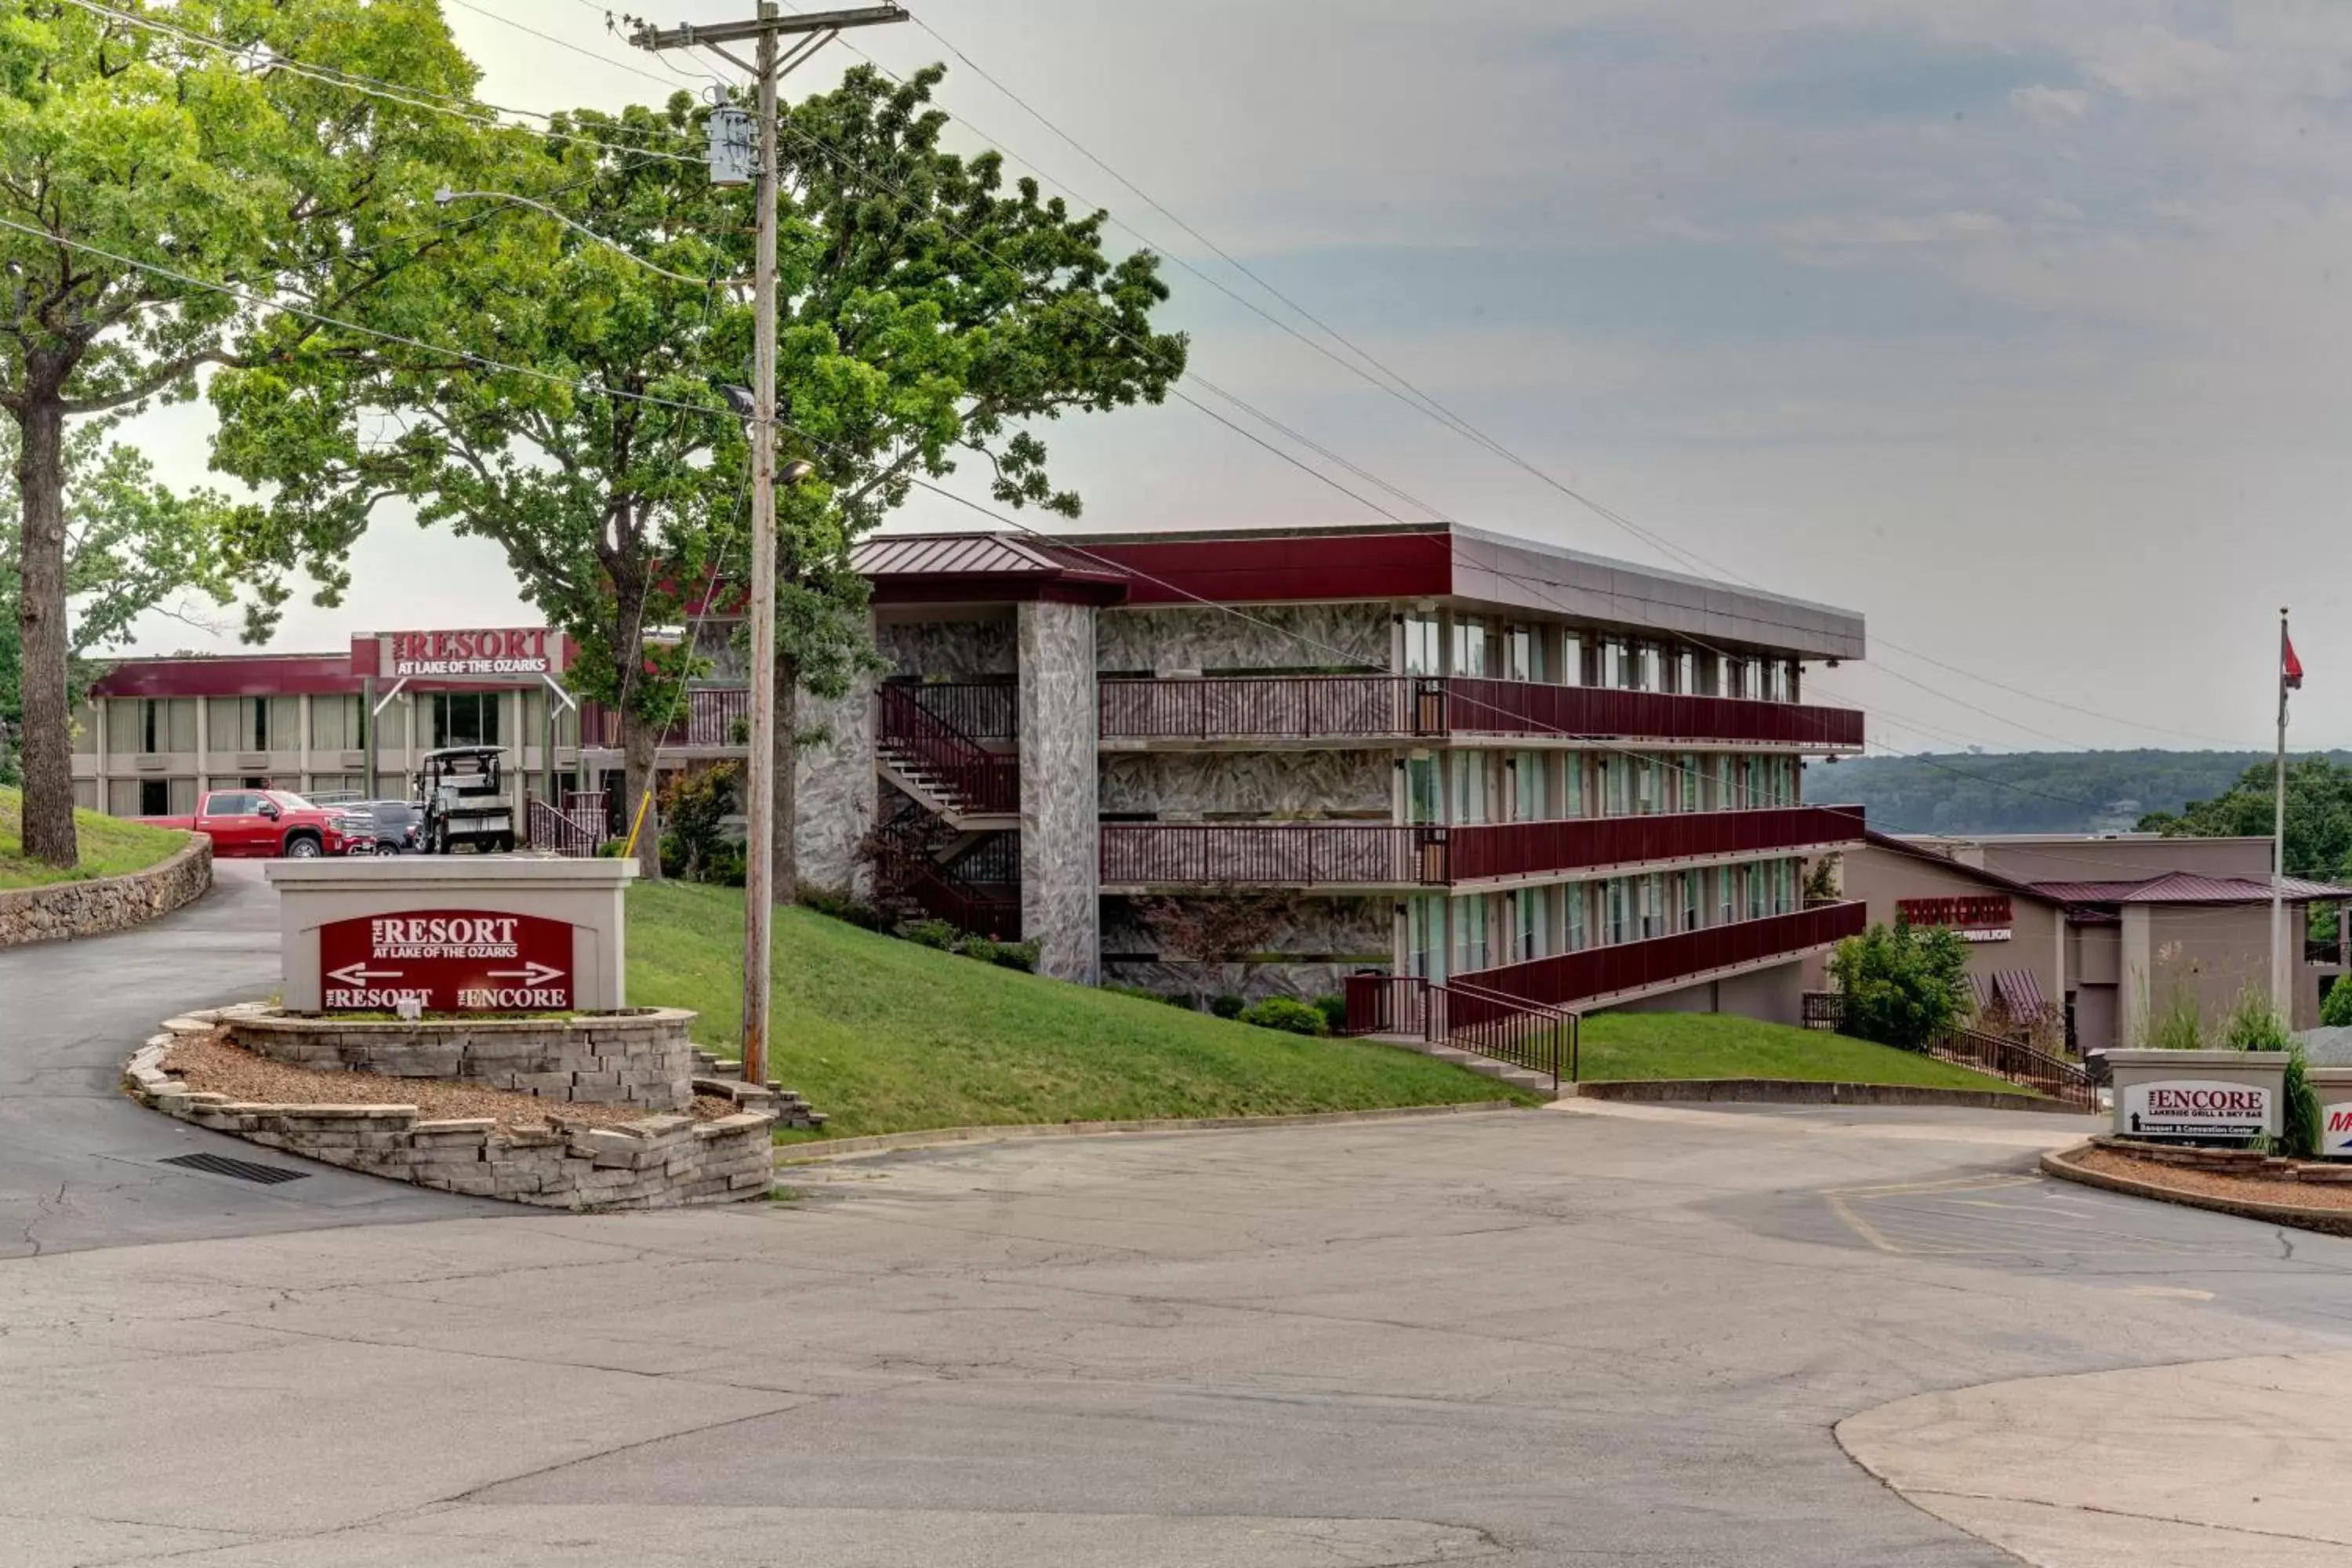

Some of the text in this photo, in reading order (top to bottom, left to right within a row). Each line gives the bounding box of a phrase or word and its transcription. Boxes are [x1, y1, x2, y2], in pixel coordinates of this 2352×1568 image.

[405, 628, 551, 660] RESORT
[398, 659, 546, 674] AT LAKE OF THE OZARKS
[372, 918, 518, 944] THE RESORT
[1963, 929, 2011, 941] PAVILION
[372, 946, 518, 958] AT LAKE OF THE OZARKS
[325, 989, 433, 1007] THE RESORT
[458, 989, 567, 1007] THE ENCORE
[2157, 1090, 2263, 1109] ENCORE
